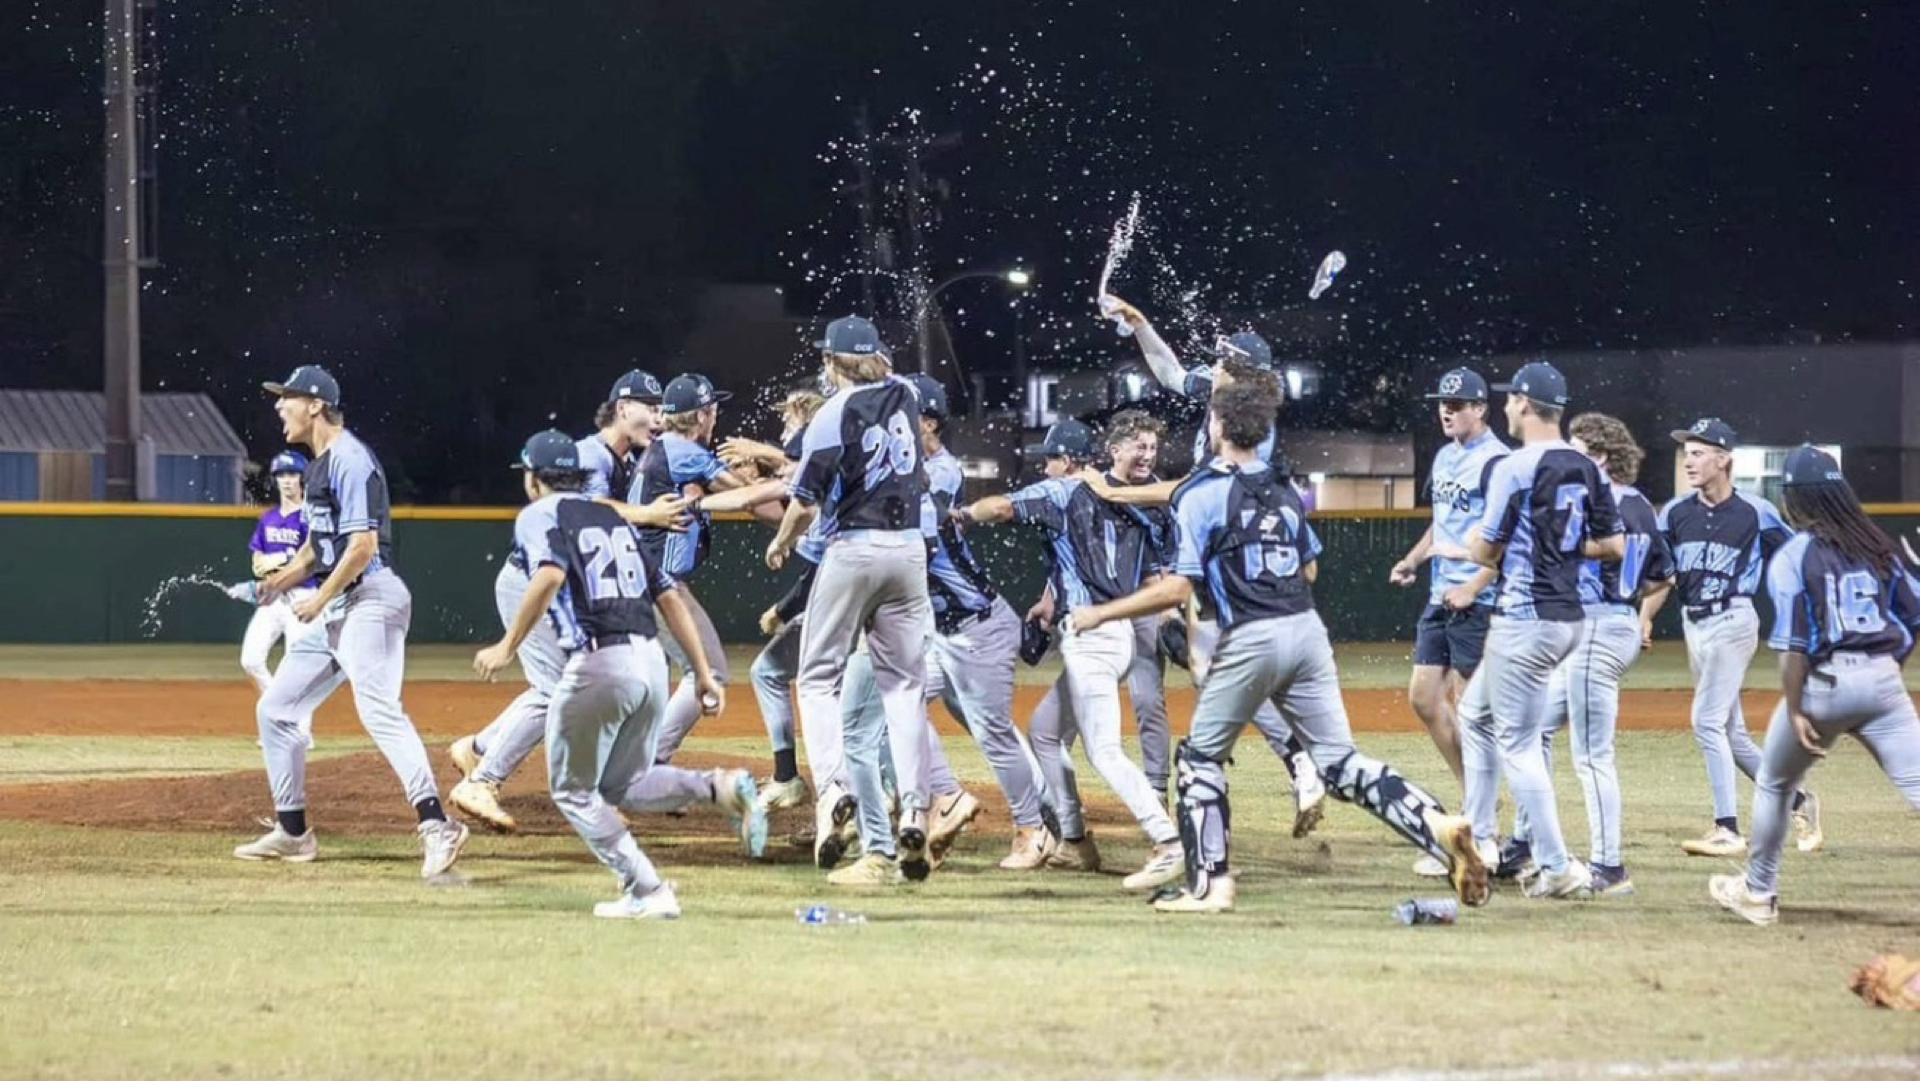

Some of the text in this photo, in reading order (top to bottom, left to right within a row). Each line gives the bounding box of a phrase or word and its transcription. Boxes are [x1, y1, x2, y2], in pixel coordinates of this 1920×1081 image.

[862, 410, 917, 492] 28
[1554, 484, 1588, 552] 7
[579, 525, 647, 600] 26
[1824, 570, 1887, 643] 16
